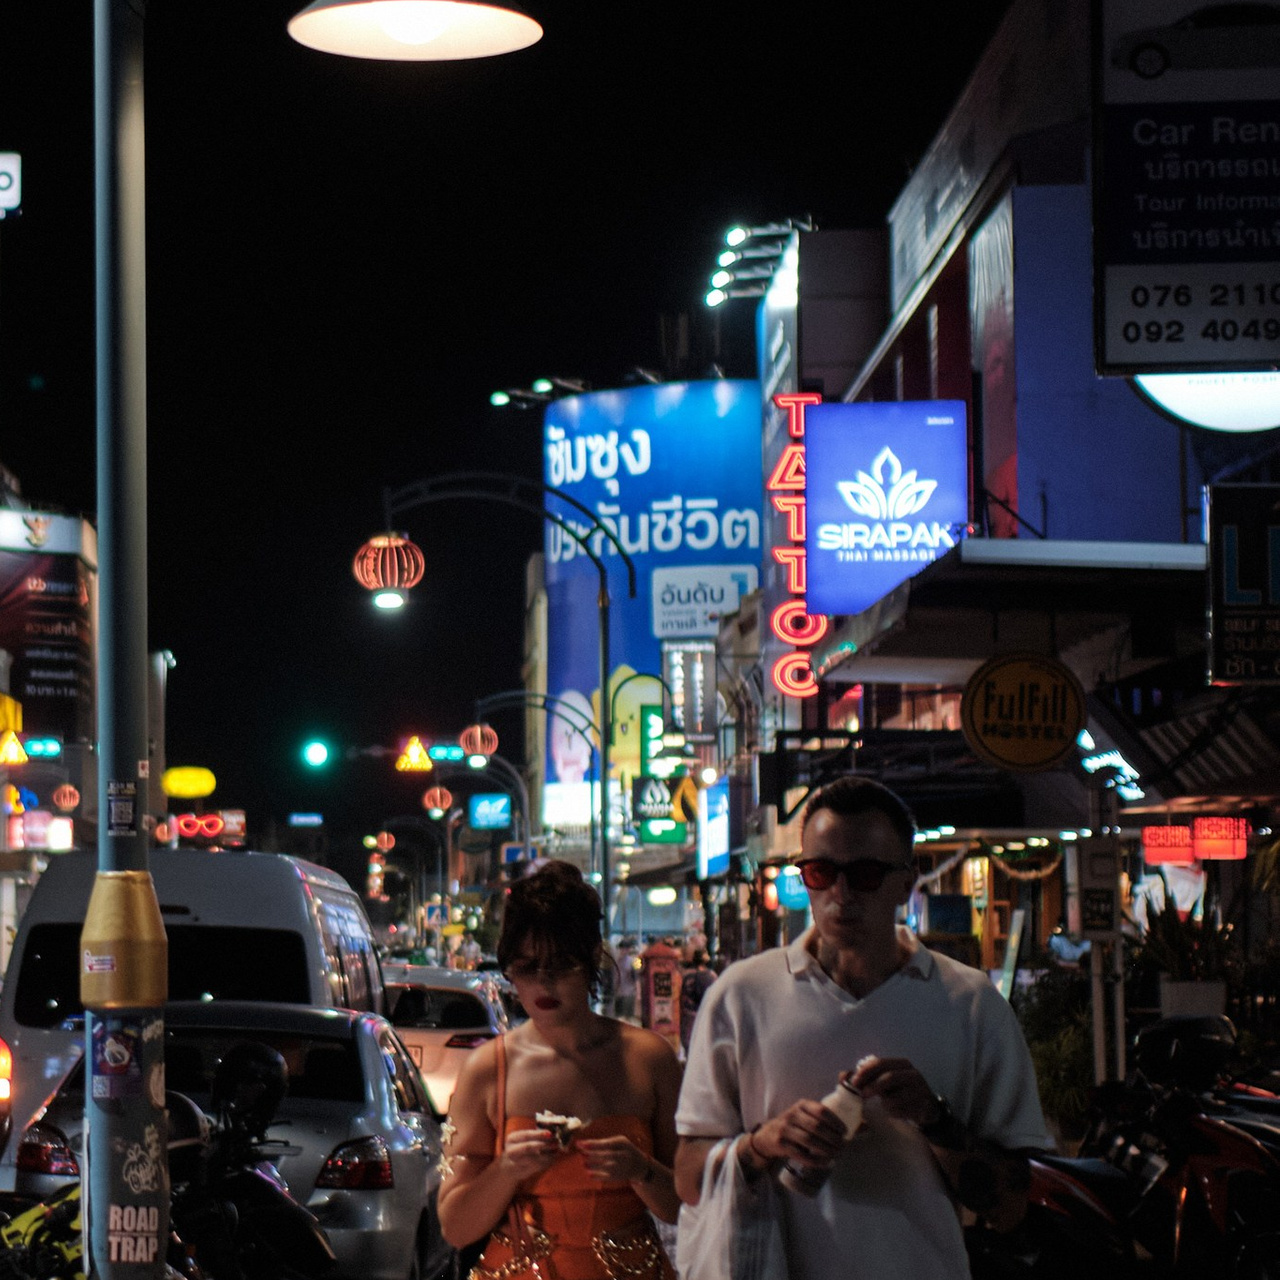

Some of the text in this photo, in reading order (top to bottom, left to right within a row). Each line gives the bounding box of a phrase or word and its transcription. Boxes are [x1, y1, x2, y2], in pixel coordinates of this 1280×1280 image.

[1132, 116, 1280, 145] Car Ren
[1134, 194, 1186, 213] Tour
[1131, 285, 1192, 308] 076
[1123, 320, 1280, 344] 092 4049
[548, 494, 761, 564] ประกันชีวิต
[817, 522, 955, 549] SIRAPAK
[837, 550, 937, 562] THAI MASSAGE
[661, 581, 725, 606] อันดับ
[982, 723, 1068, 742] HOSTEL
[108, 1204, 159, 1232] ROAD
[108, 1235, 159, 1263] TRAP
